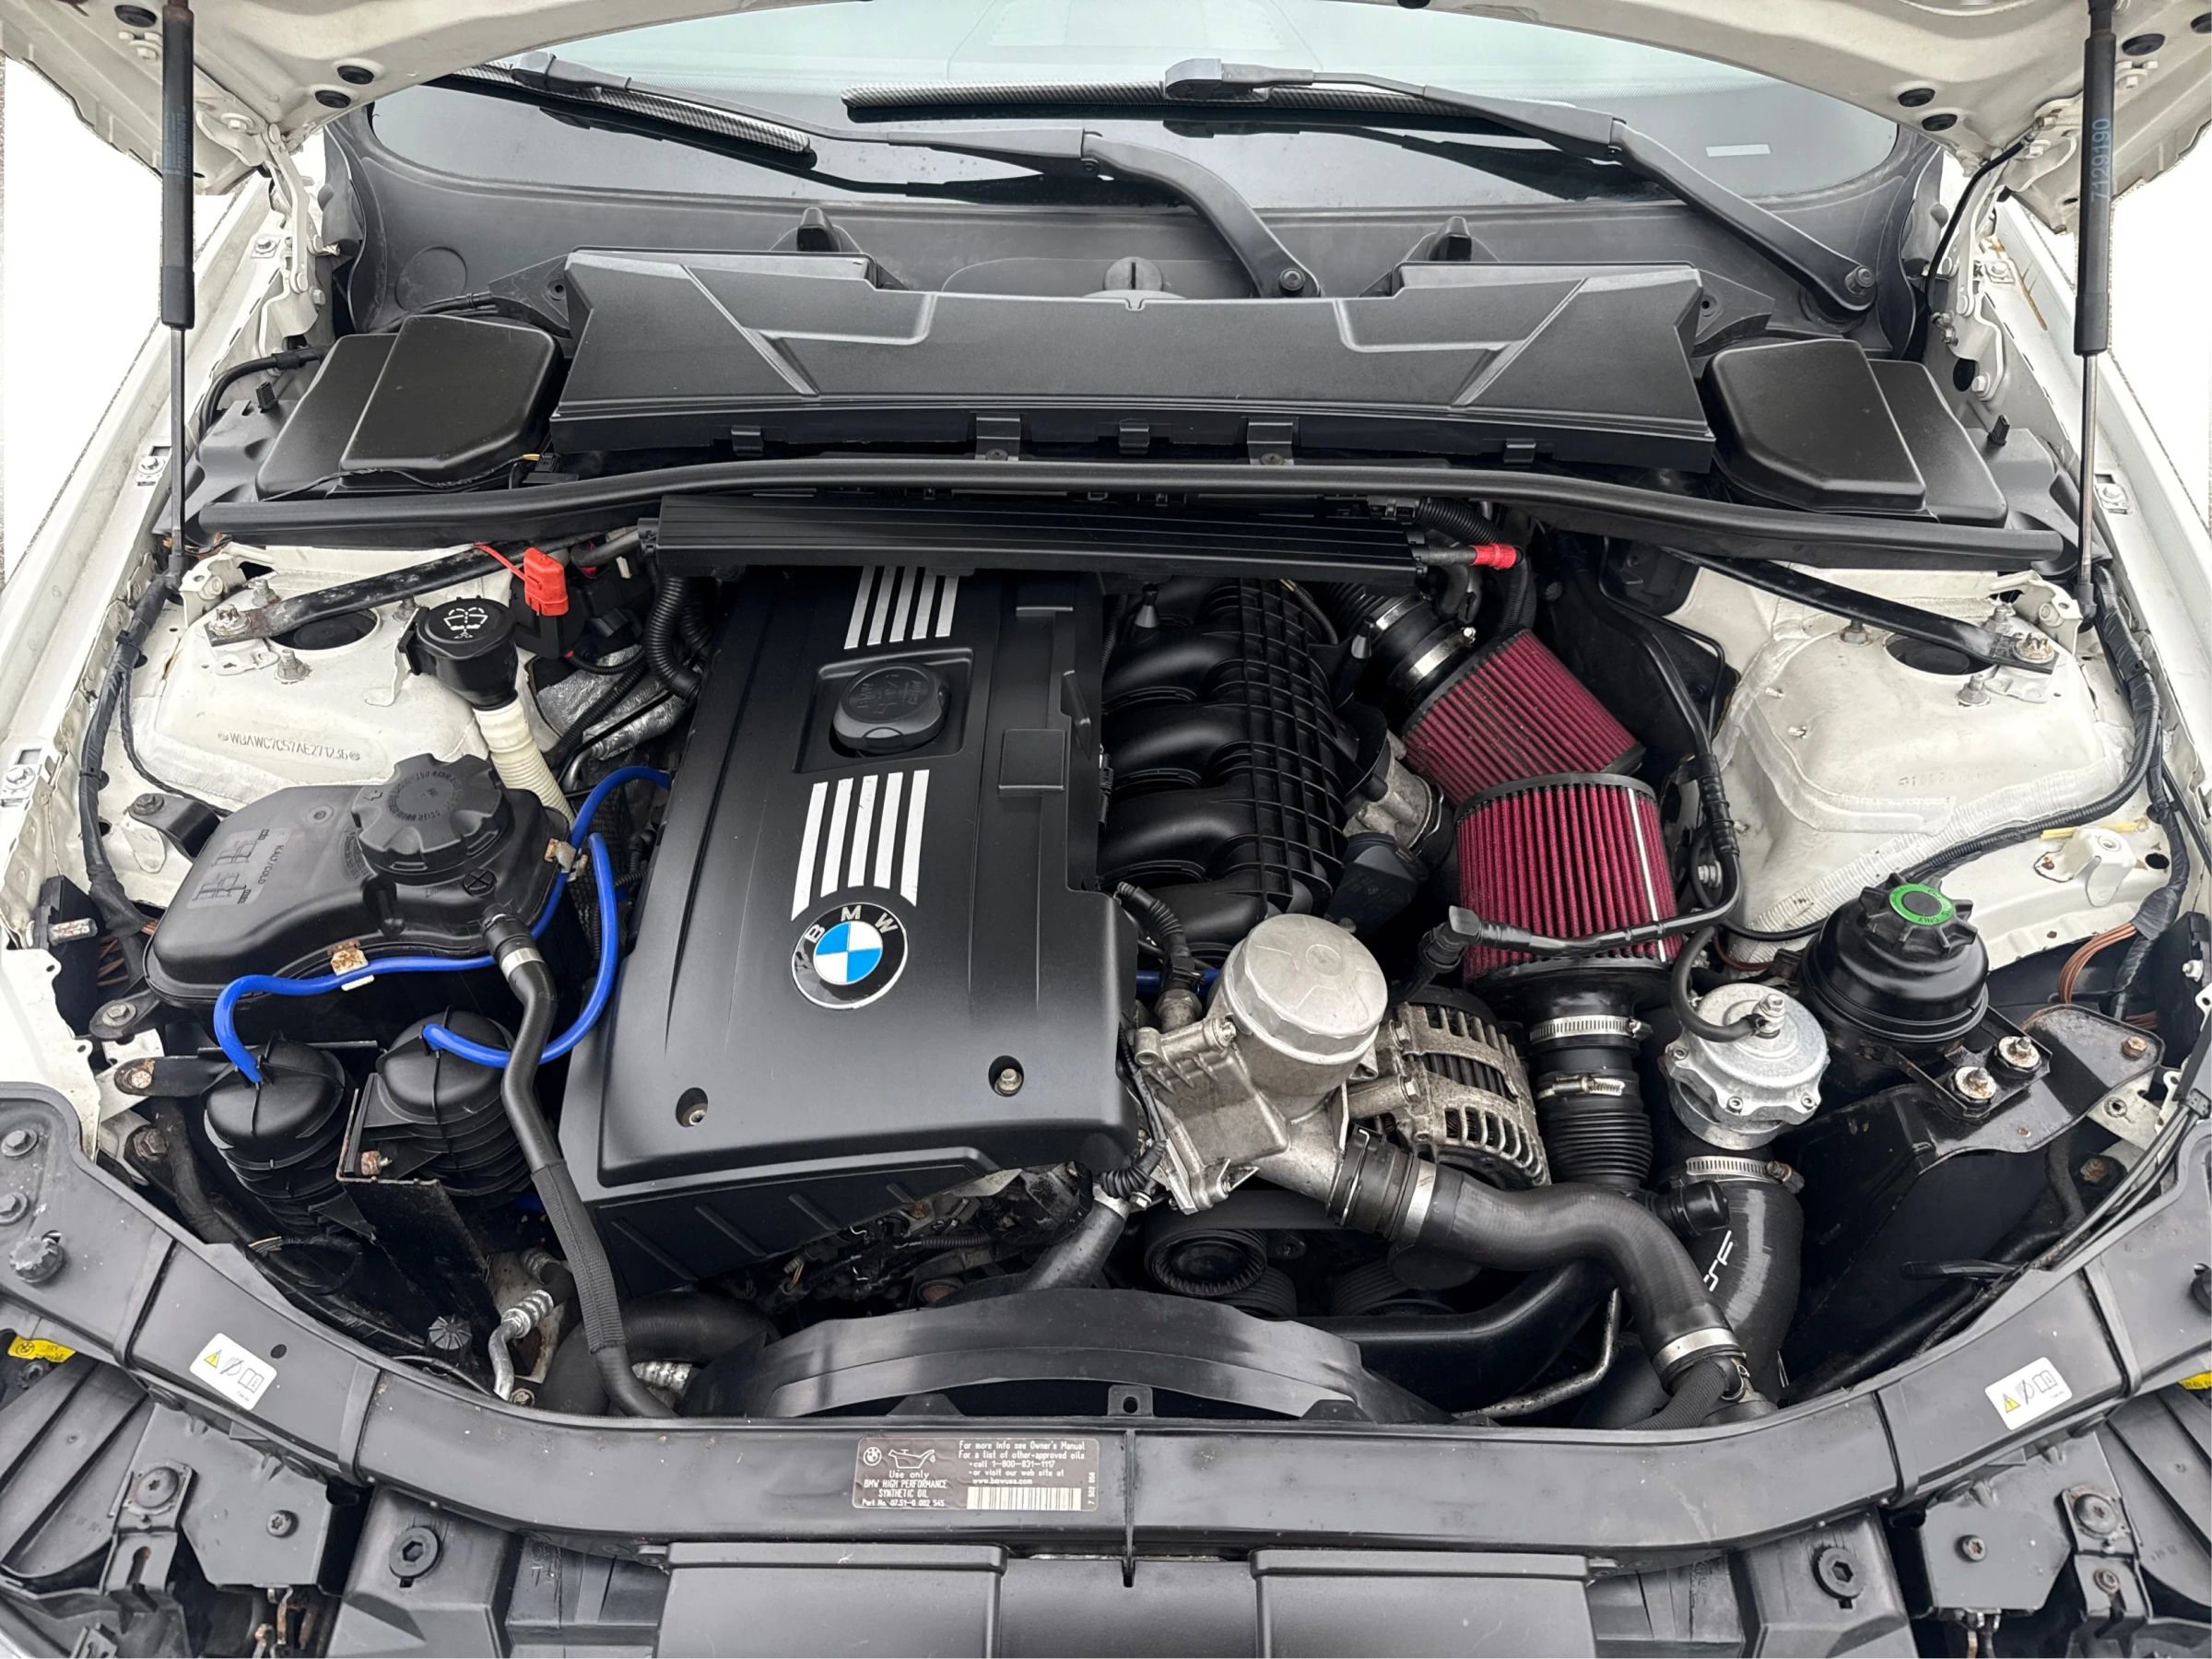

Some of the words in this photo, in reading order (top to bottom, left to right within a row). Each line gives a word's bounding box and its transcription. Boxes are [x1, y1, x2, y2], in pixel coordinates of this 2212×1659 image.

[2090, 118, 2112, 203] 7129190
[804, 904, 899, 944] BMW
[959, 1440, 971, 1450] For
[996, 1440, 1011, 1450] info
[1030, 1440, 1058, 1450] Owner's
[1061, 1441, 1086, 1451] Manual
[959, 1449, 971, 1459] For
[982, 1449, 996, 1459] list
[999, 1450, 1008, 1459] of
[1070, 1451, 1085, 1460] oils
[888, 1469, 905, 1478] Use
[910, 1469, 930, 1481] only
[984, 1467, 1002, 1477] visit
[1021, 1468, 1035, 1477] web
[1038, 1468, 1053, 1477] site
[1056, 1468, 1065, 1477] at
[864, 1478, 880, 1488] BMW
[882, 1478, 899, 1488] HIGH
[900, 1479, 948, 1489] PERFORMANCE
[877, 1488, 915, 1498] SYNTHETIC
[917, 1488, 930, 1499] OIL
[862, 1499, 875, 1507] Part
